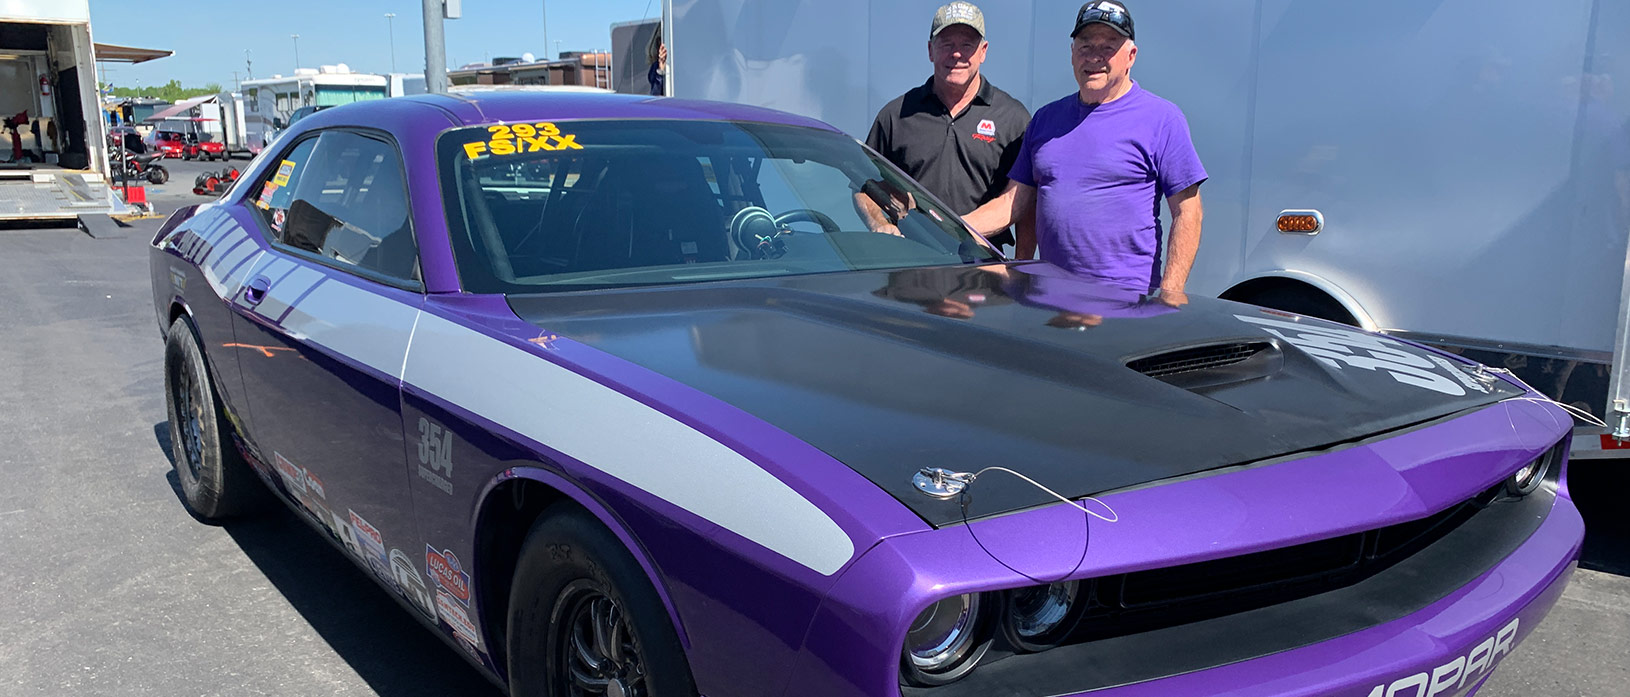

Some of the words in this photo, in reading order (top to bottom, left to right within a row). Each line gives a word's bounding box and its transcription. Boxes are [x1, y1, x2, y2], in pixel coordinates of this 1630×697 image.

[488, 122, 560, 140] 293
[417, 416, 453, 478] 354
[430, 556, 453, 581] LUCAS
[453, 574, 465, 592] OIL
